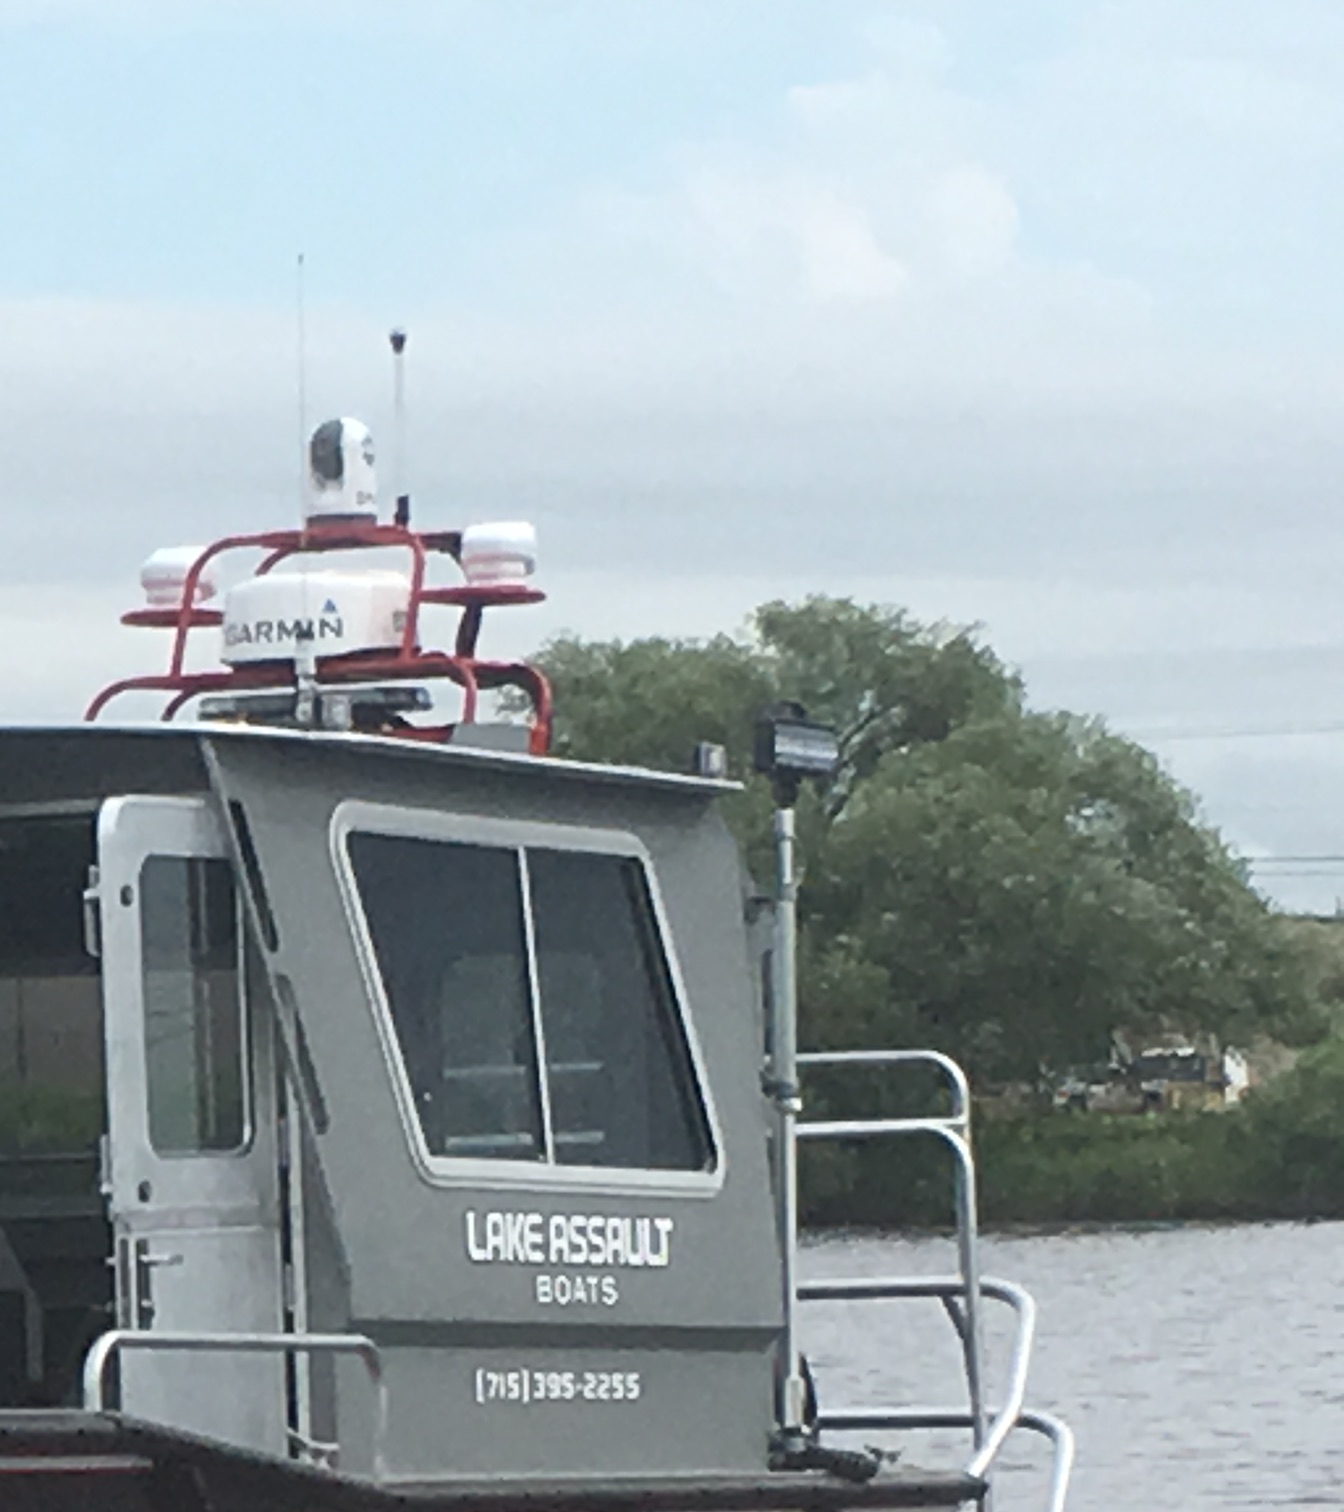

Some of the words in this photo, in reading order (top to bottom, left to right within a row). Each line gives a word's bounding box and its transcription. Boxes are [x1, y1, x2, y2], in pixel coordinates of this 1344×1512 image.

[465, 1210, 545, 1263] LAKE
[549, 1214, 674, 1266] ASSAULT
[535, 1275, 619, 1305] BOATS
